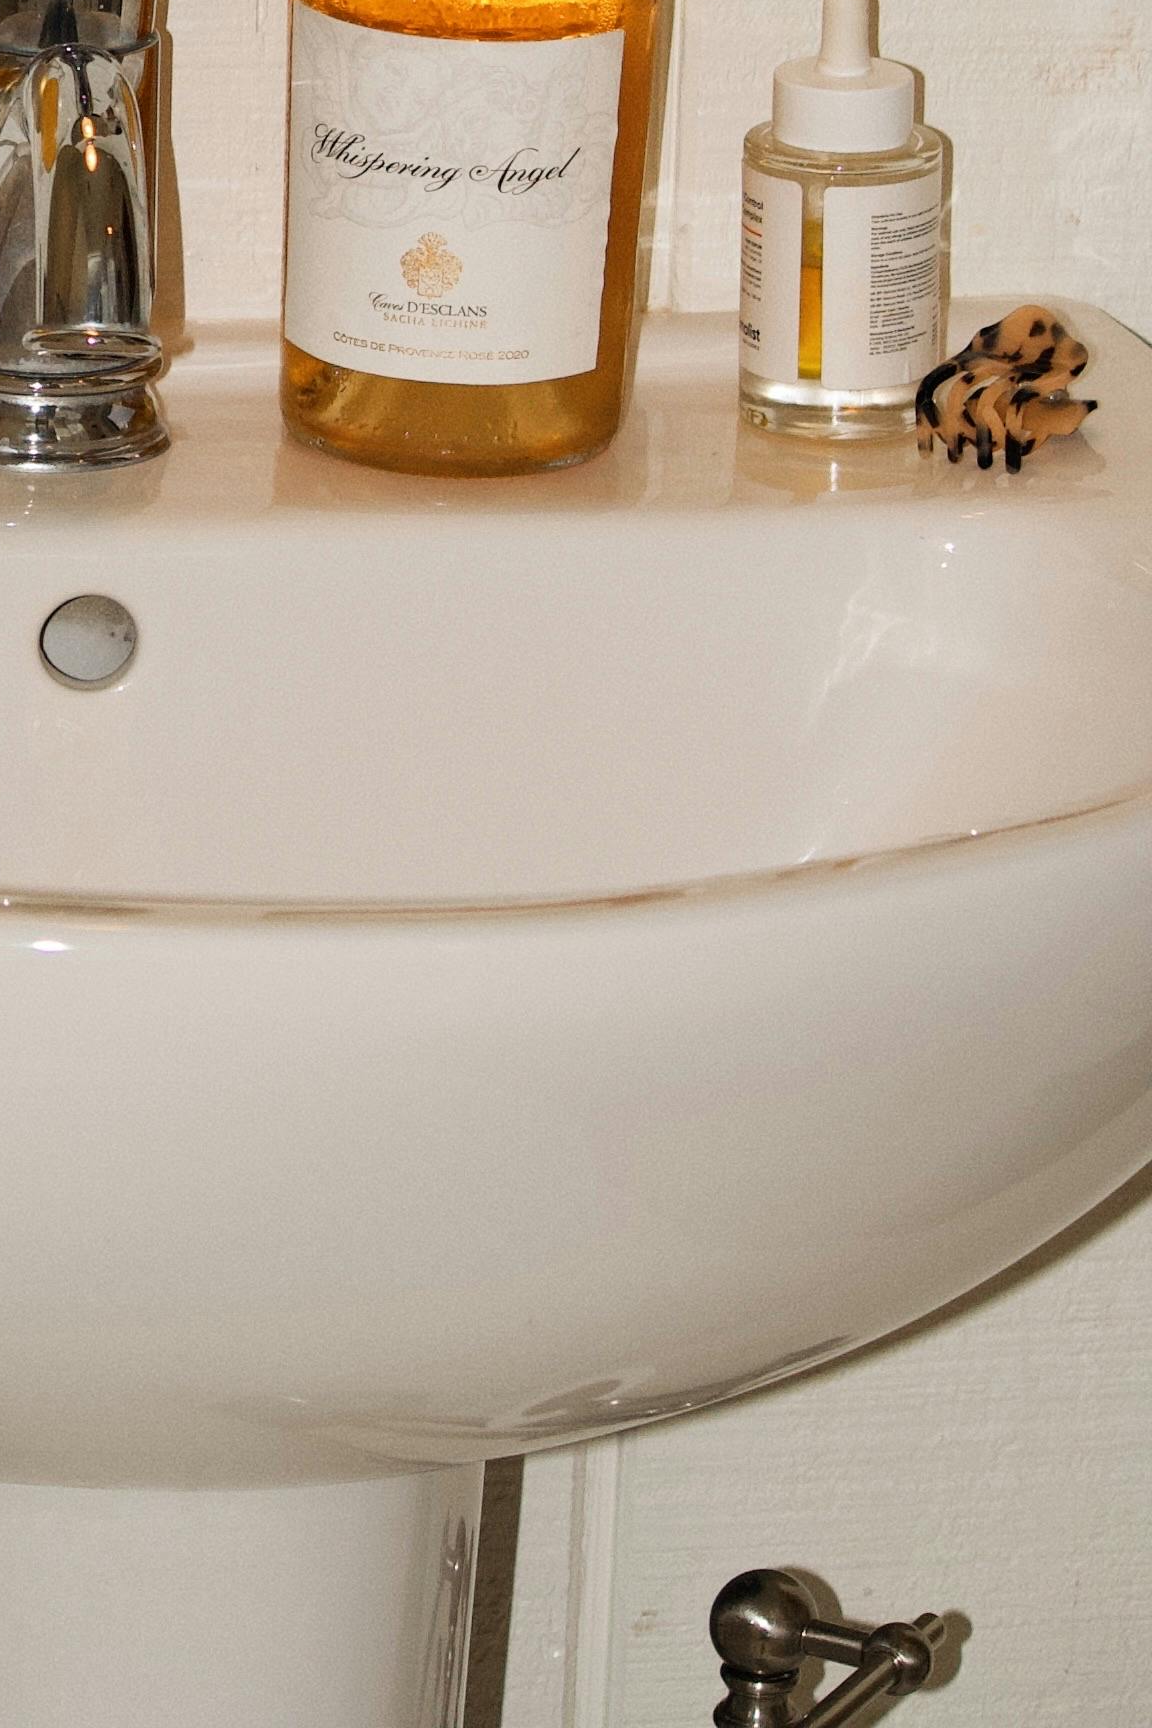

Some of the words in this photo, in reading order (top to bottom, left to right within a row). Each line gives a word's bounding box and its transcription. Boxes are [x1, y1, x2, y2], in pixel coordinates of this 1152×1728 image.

[311, 123, 462, 192] Whispering
[469, 147, 582, 195] Angel
[368, 291, 404, 312] Caves
[407, 301, 488, 318] D'ESCLANS
[383, 312, 426, 327] SACHA
[333, 330, 368, 349] CÔTES
[370, 340, 386, 352] DE
[388, 343, 455, 360] PROVENCE
[498, 350, 530, 361] 2020
